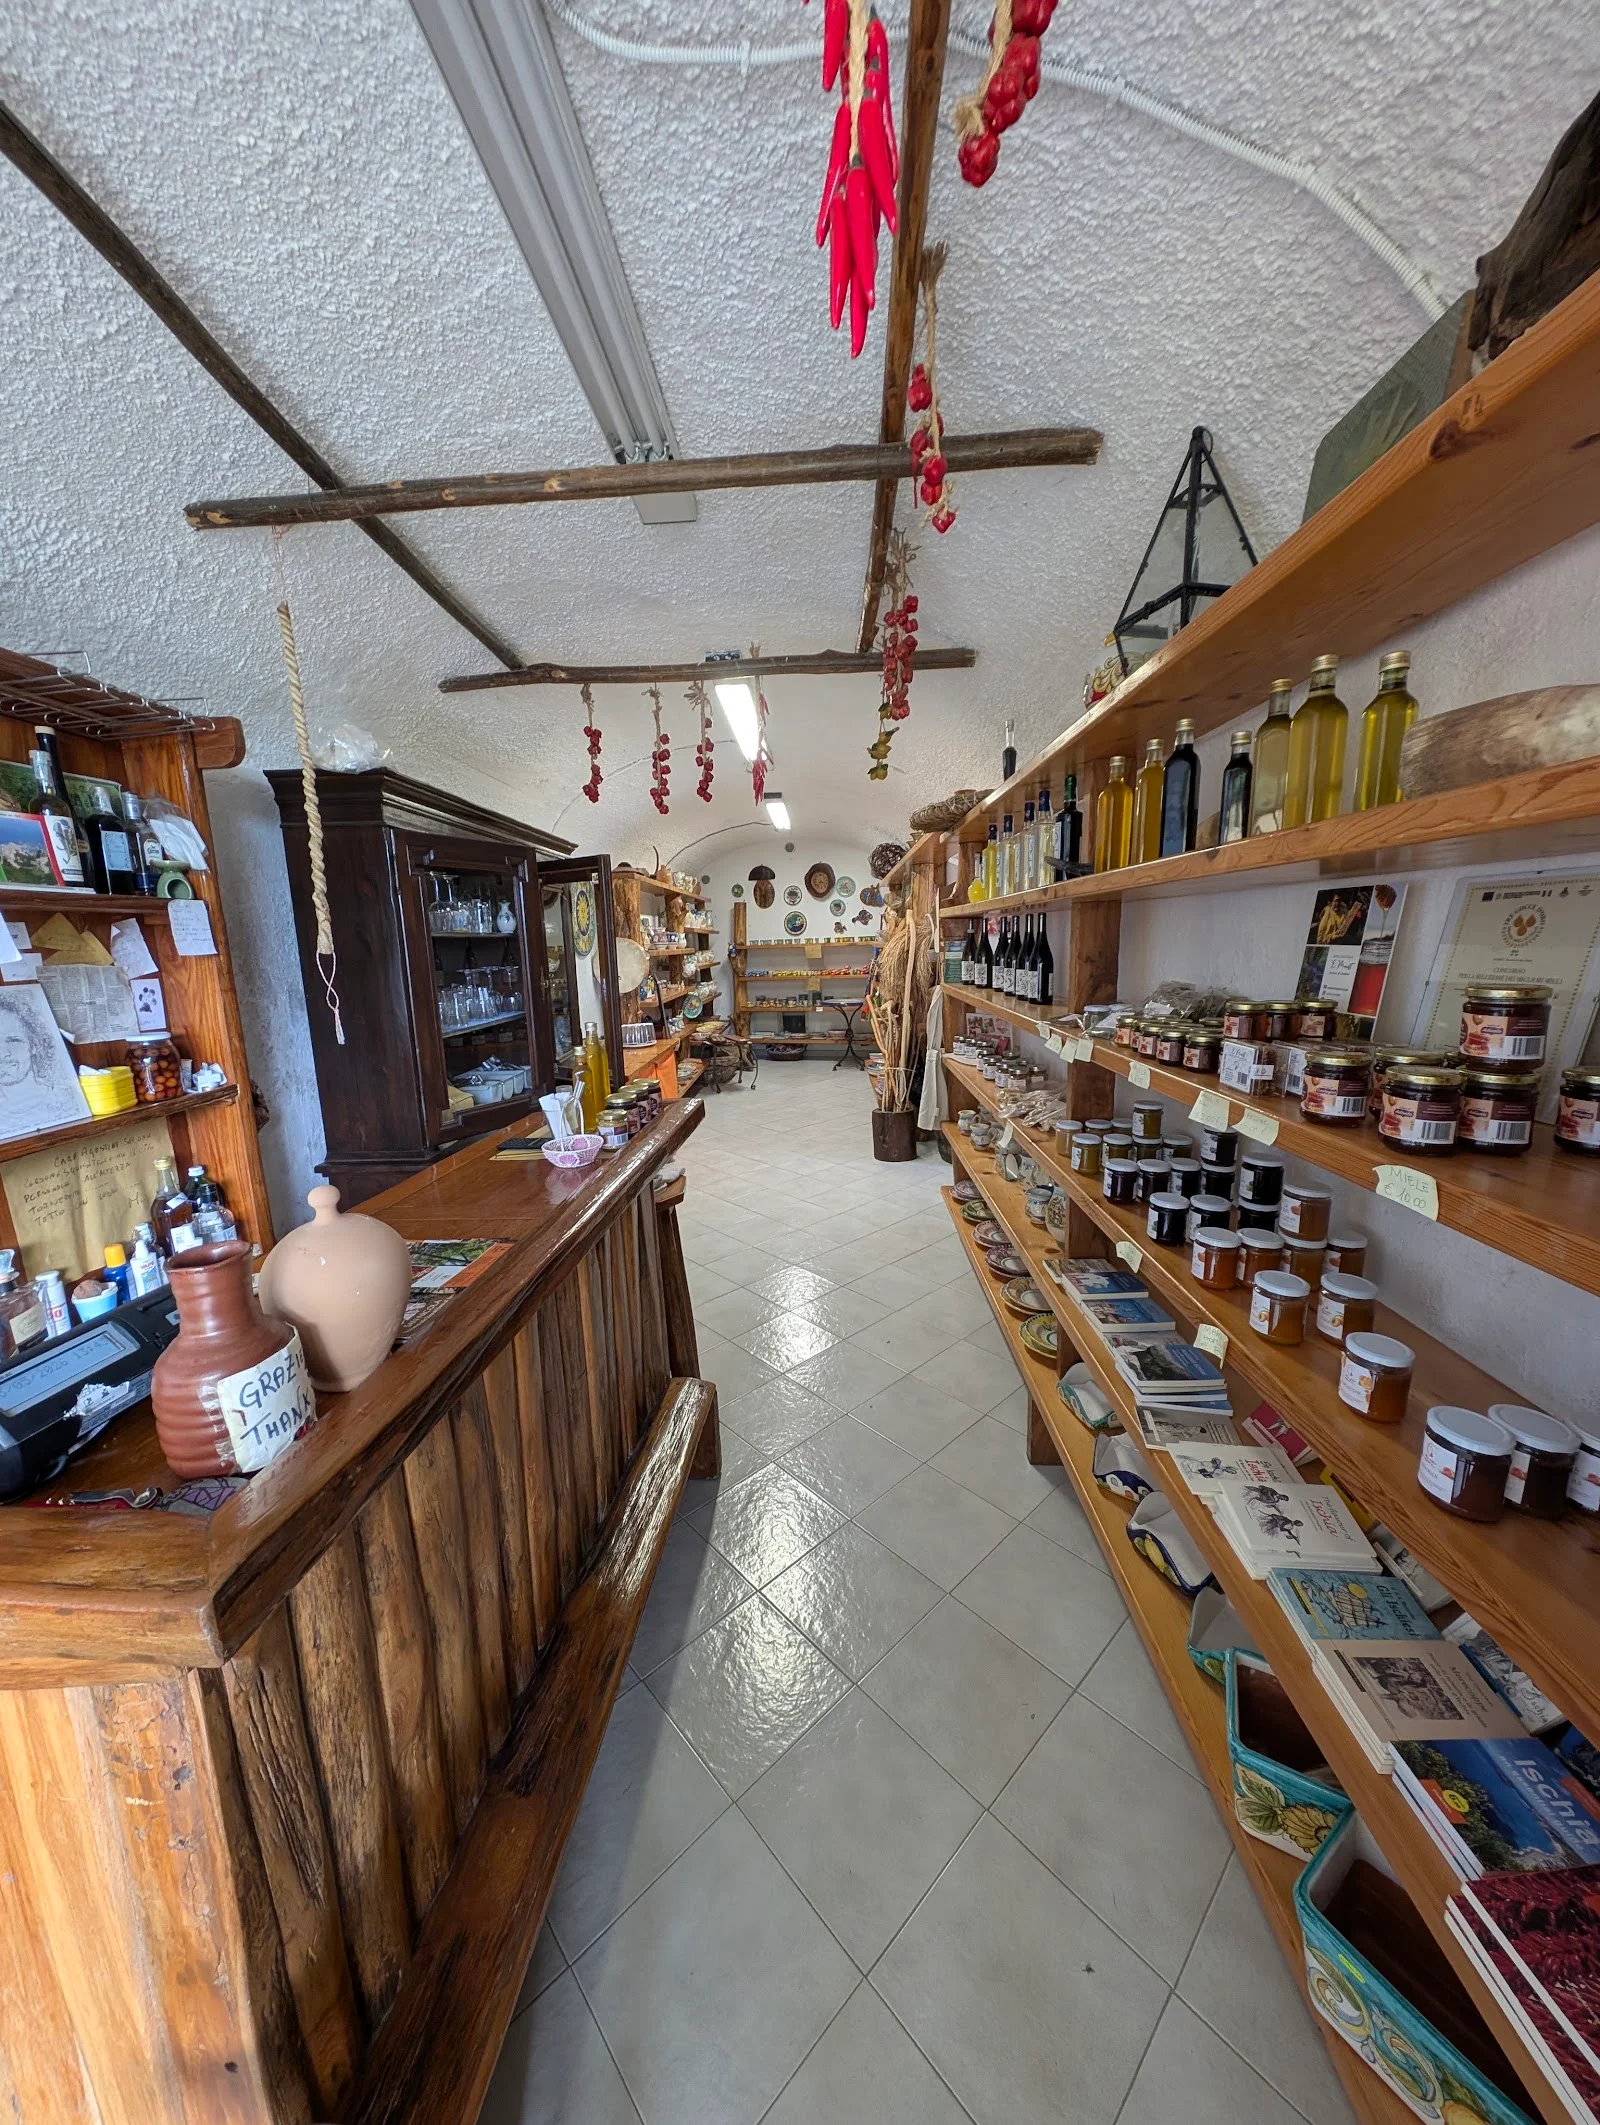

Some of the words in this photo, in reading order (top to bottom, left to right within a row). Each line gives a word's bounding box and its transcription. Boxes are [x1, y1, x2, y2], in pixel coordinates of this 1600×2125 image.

[1389, 1166, 1430, 1194] MIELE
[1310, 1498, 1339, 1538] Ischia
[1513, 1758, 1600, 1847] Ischia
